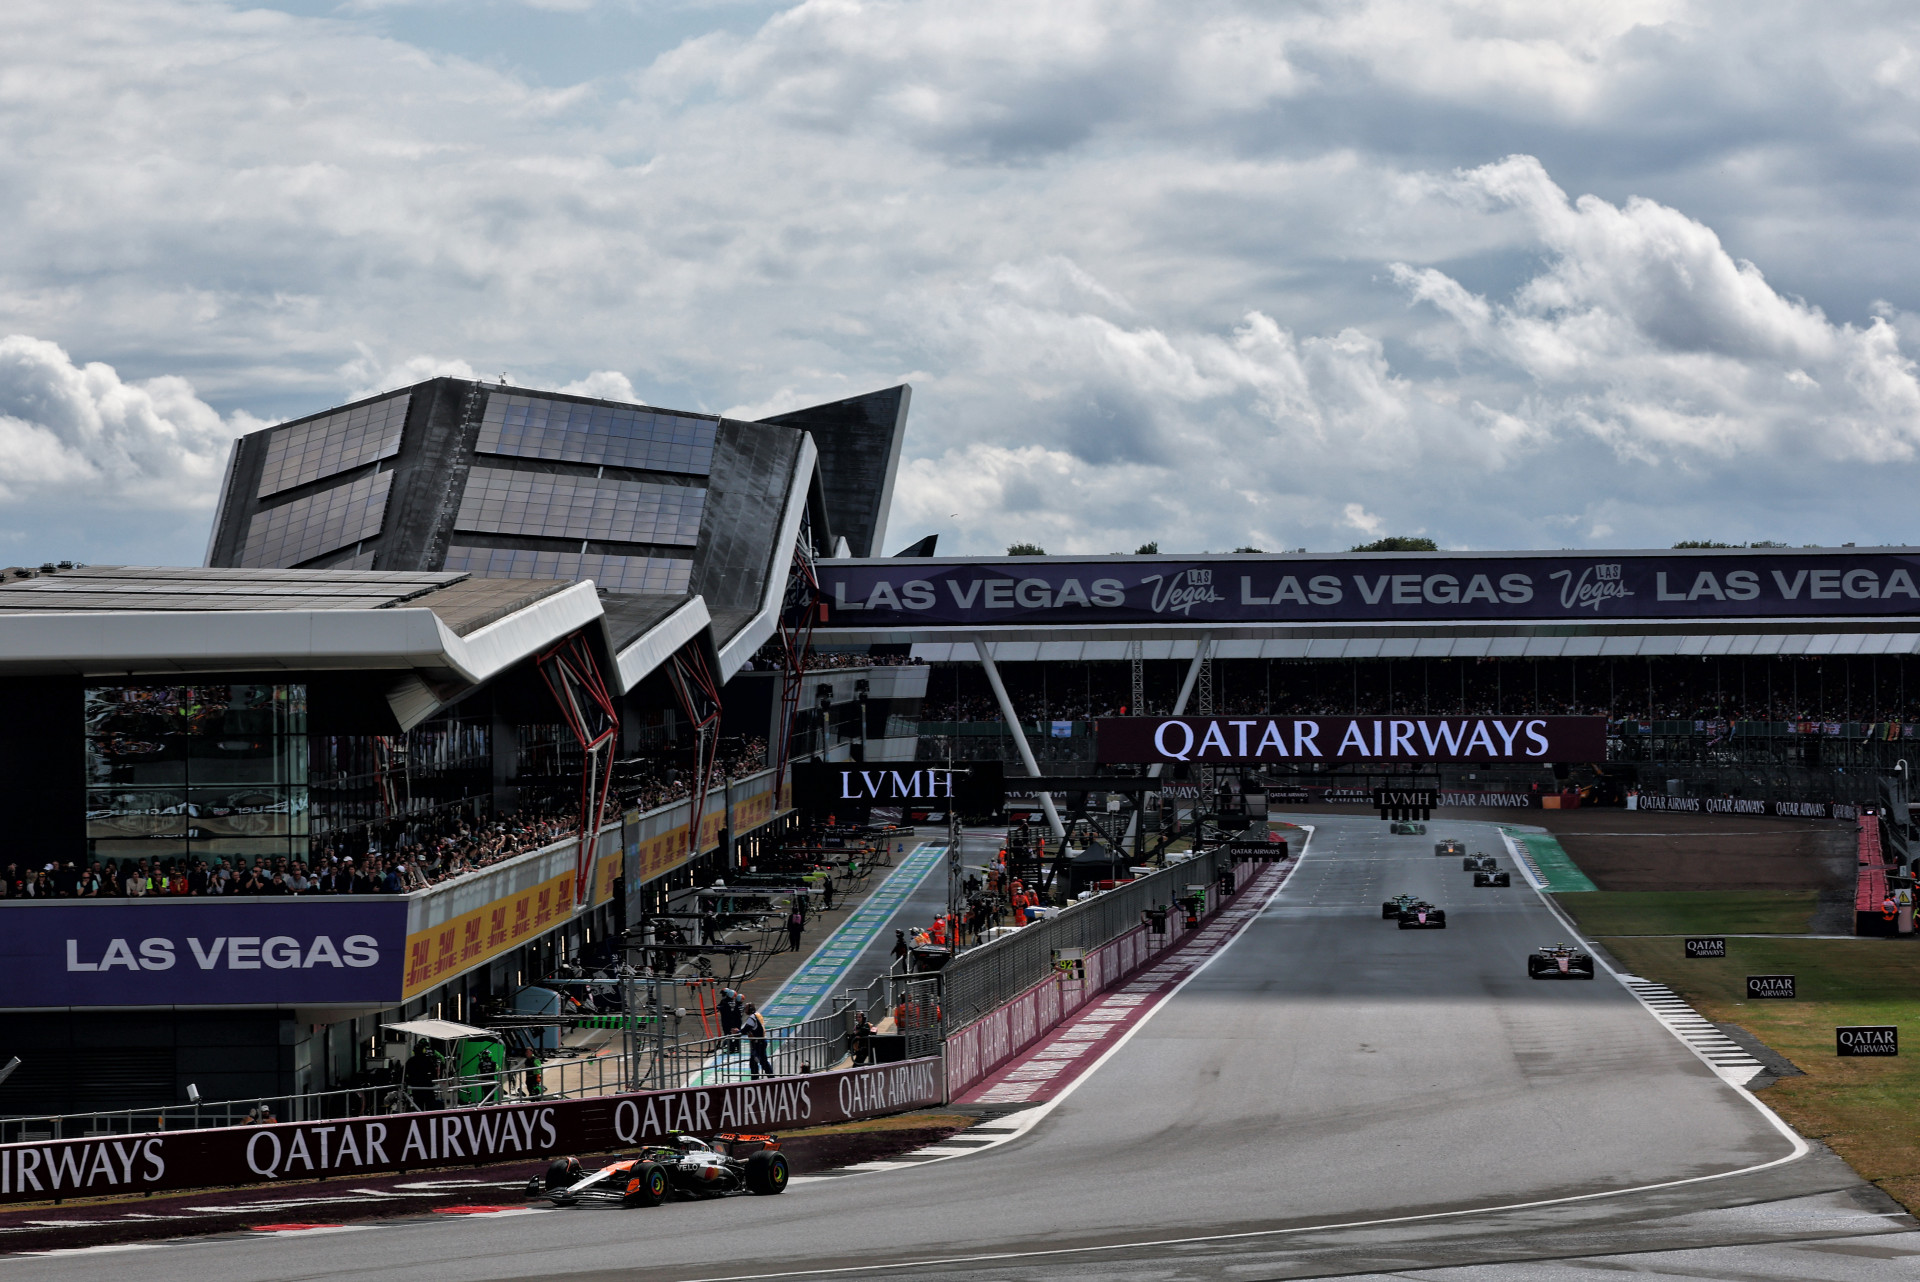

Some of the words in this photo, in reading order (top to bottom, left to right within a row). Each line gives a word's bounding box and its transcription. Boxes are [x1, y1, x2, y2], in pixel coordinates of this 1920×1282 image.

[835, 579, 936, 611] LAS
[946, 577, 1126, 610] VEGAS
[1140, 573, 1225, 616] Vegas
[1240, 575, 1343, 605] LAS
[1353, 573, 1534, 605] VEGAS
[1549, 569, 1634, 612] Vegas
[1656, 570, 1761, 601] LAS
[1771, 568, 1920, 600] VEGA
[1153, 719, 1324, 761] QATAR
[1336, 719, 1551, 757] AIRWAYS
[840, 770, 956, 799] LVMH
[1381, 792, 1430, 805] LVMH
[1437, 793, 1477, 806] QATAR
[1478, 794, 1529, 807] AIRWAYS
[1639, 795, 1666, 810] QATAR
[1667, 797, 1700, 812] AIRWAYS
[1706, 798, 1733, 813] QATAR
[1733, 799, 1765, 814] AIRWAYS
[1776, 801, 1799, 817] QATAR
[1799, 802, 1826, 817] AIRWAYS
[1231, 848, 1252, 856] QATAR
[66, 937, 176, 972] LAS
[187, 934, 380, 970] VEGAS
[1687, 940, 1724, 951] QATAR
[1750, 978, 1793, 991] QATAR
[1760, 989, 1794, 997] AIRWAYS
[1840, 1030, 1895, 1045] QATAR
[1853, 1044, 1896, 1054] AIRWAYS
[839, 1071, 886, 1118] QATAR
[888, 1062, 934, 1107] AIRWAYS
[614, 1091, 712, 1144] QATAR
[719, 1080, 812, 1129] AIRWAYS
[246, 1122, 391, 1178] QATAR
[400, 1107, 557, 1162] AIRWAYS
[1, 1138, 165, 1194] IRWAYS
[676, 1163, 699, 1171] VELO
